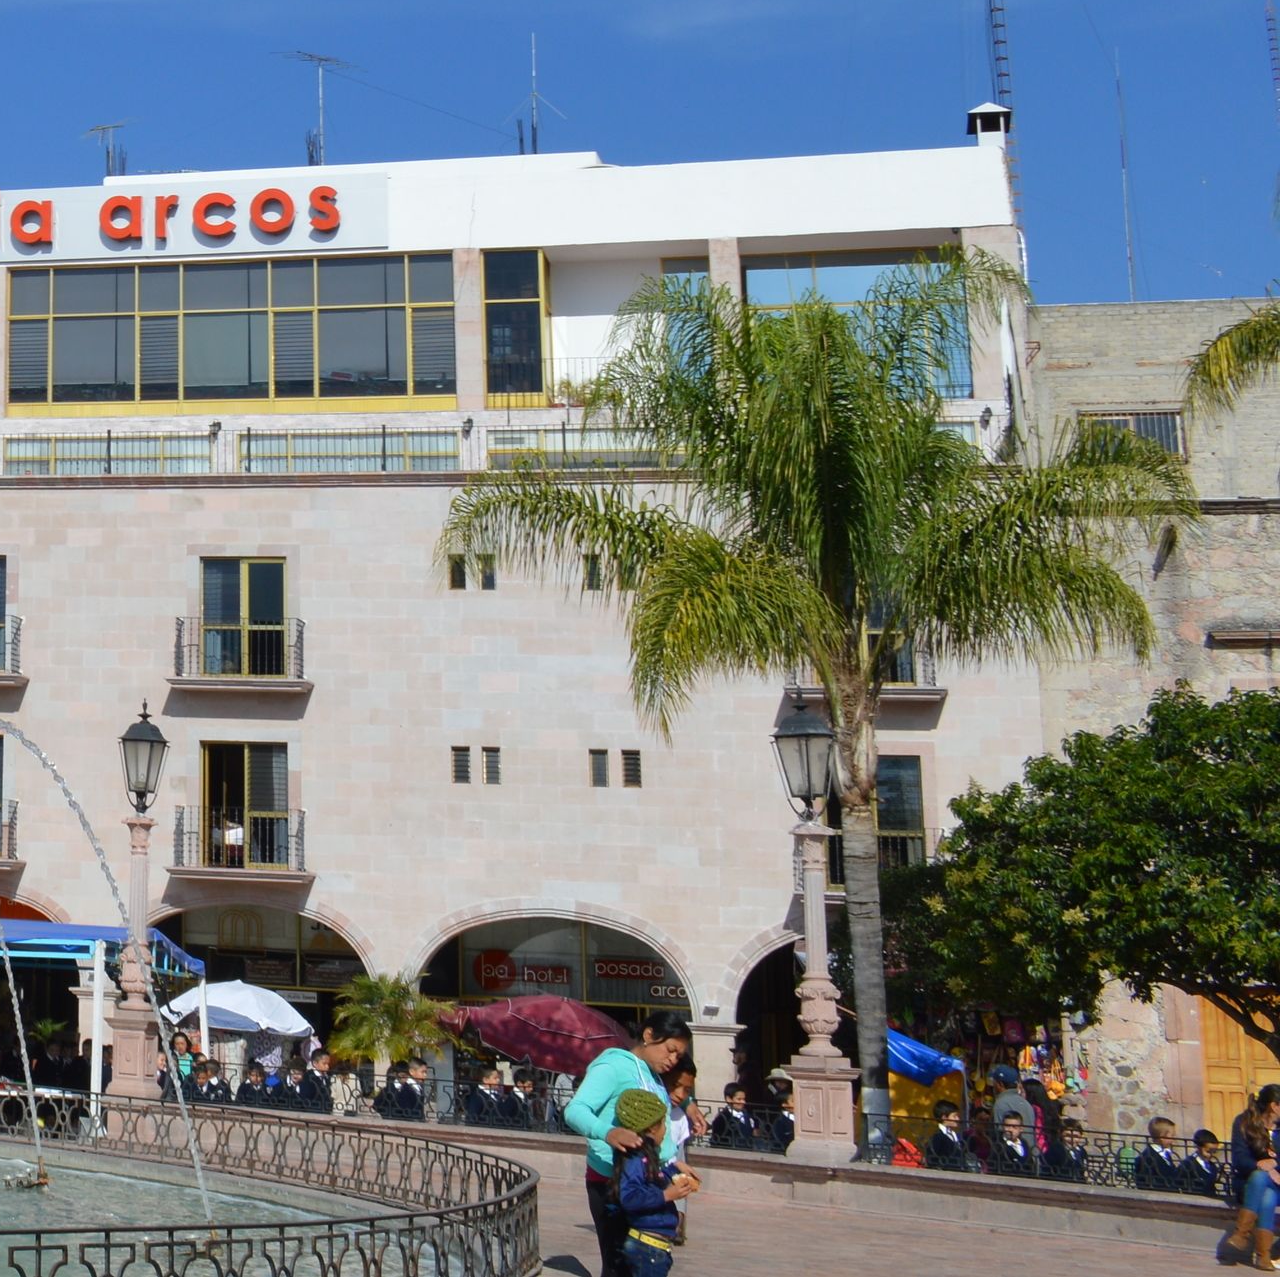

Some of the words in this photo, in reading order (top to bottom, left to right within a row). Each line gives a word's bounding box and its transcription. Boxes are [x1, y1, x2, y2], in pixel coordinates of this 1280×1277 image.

[99, 185, 341, 241] arcos
[524, 966, 568, 984] hotel
[594, 958, 665, 979] posada
[650, 984, 688, 998] arco
